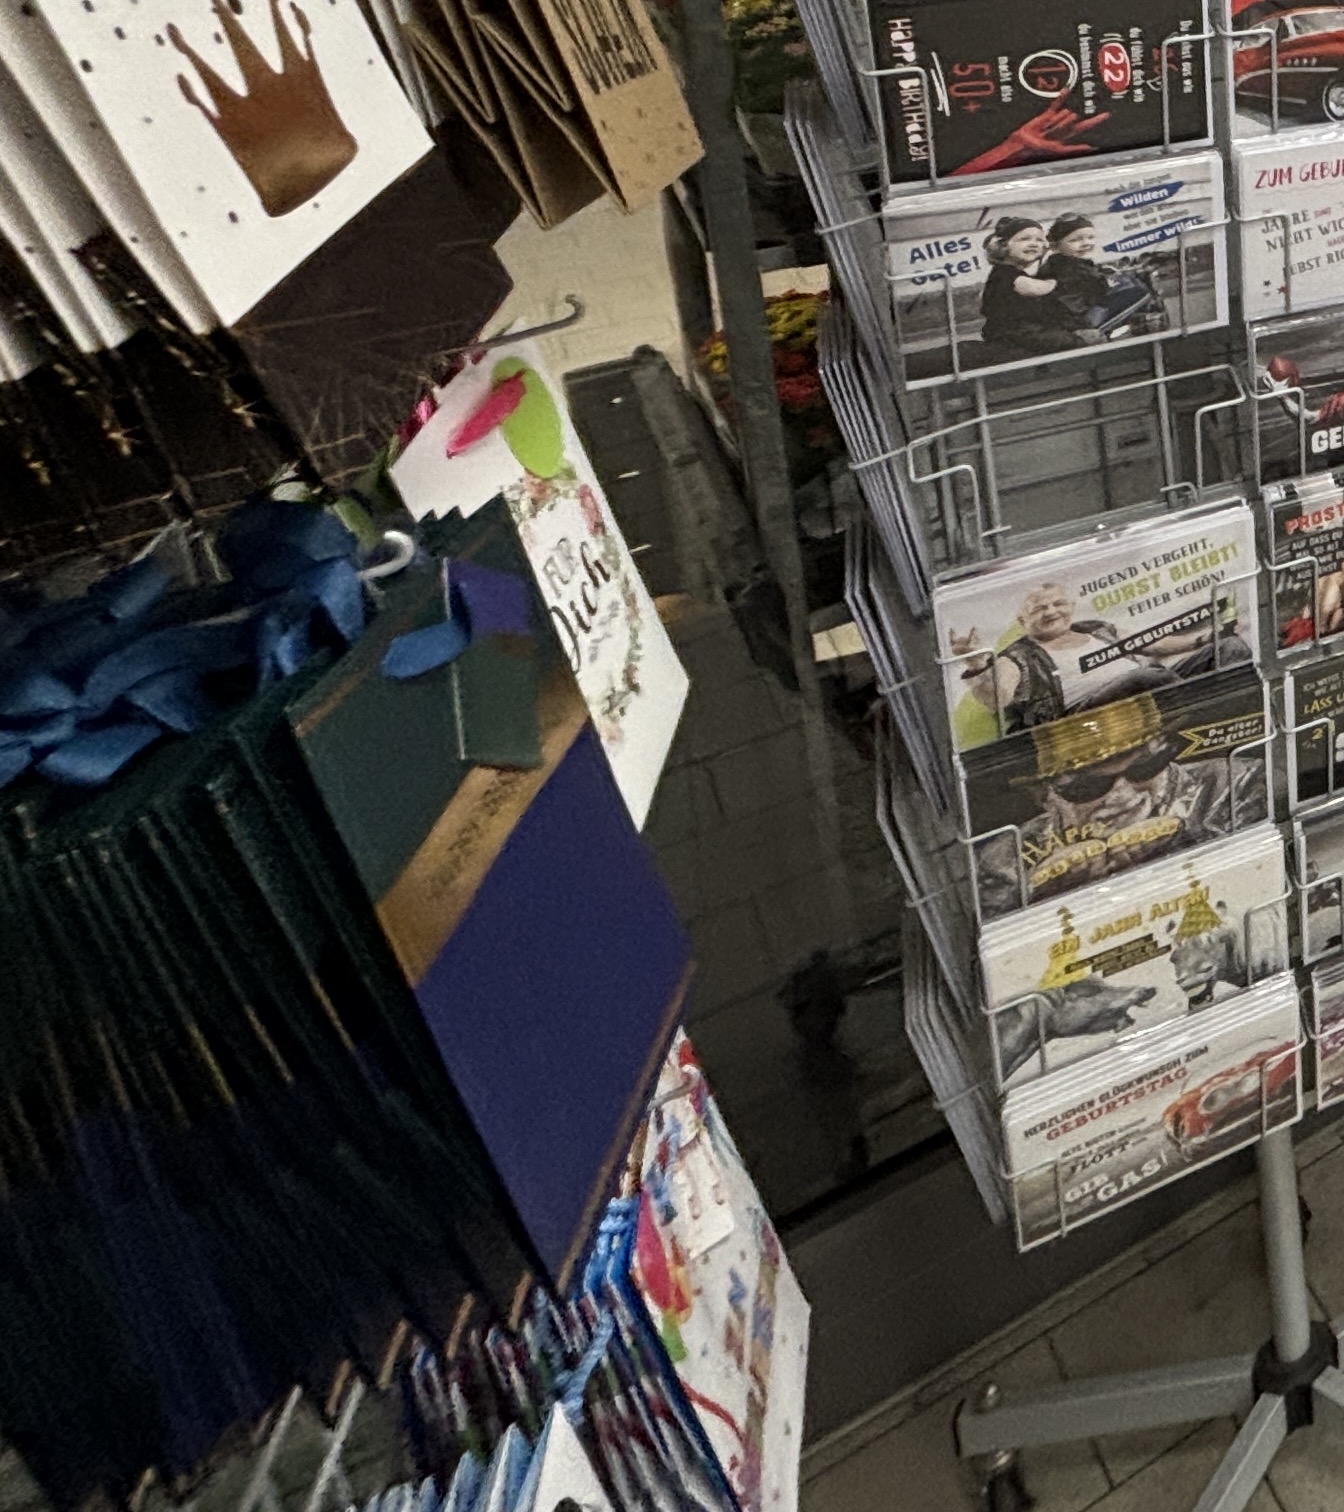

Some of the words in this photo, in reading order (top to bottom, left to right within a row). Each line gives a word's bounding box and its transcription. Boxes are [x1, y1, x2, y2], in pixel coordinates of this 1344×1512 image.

[1027, 62, 1068, 92] 12
[1103, 51, 1124, 83] 22
[1254, 166, 1293, 190] ZUM
[1119, 188, 1169, 208] Wilden
[1260, 209, 1310, 236] JARE
[908, 235, 973, 264] Alles
[1115, 229, 1163, 252] immer
[909, 256, 981, 286] Gute!
[1078, 556, 1140, 599] JUGEND
[1090, 574, 1163, 613] DURST
[1166, 541, 1239, 582] BLEIBT!
[1127, 592, 1172, 618] FEIER
[1085, 644, 1122, 670] ZUM
[1023, 1099, 1098, 1141] HERZLICHEN
[1184, 1044, 1210, 1064] ZUM
[1044, 1065, 1188, 1142] GEBURTSTAG
[1063, 1172, 1110, 1204] GIB
[1096, 1148, 1170, 1204] GAS!
